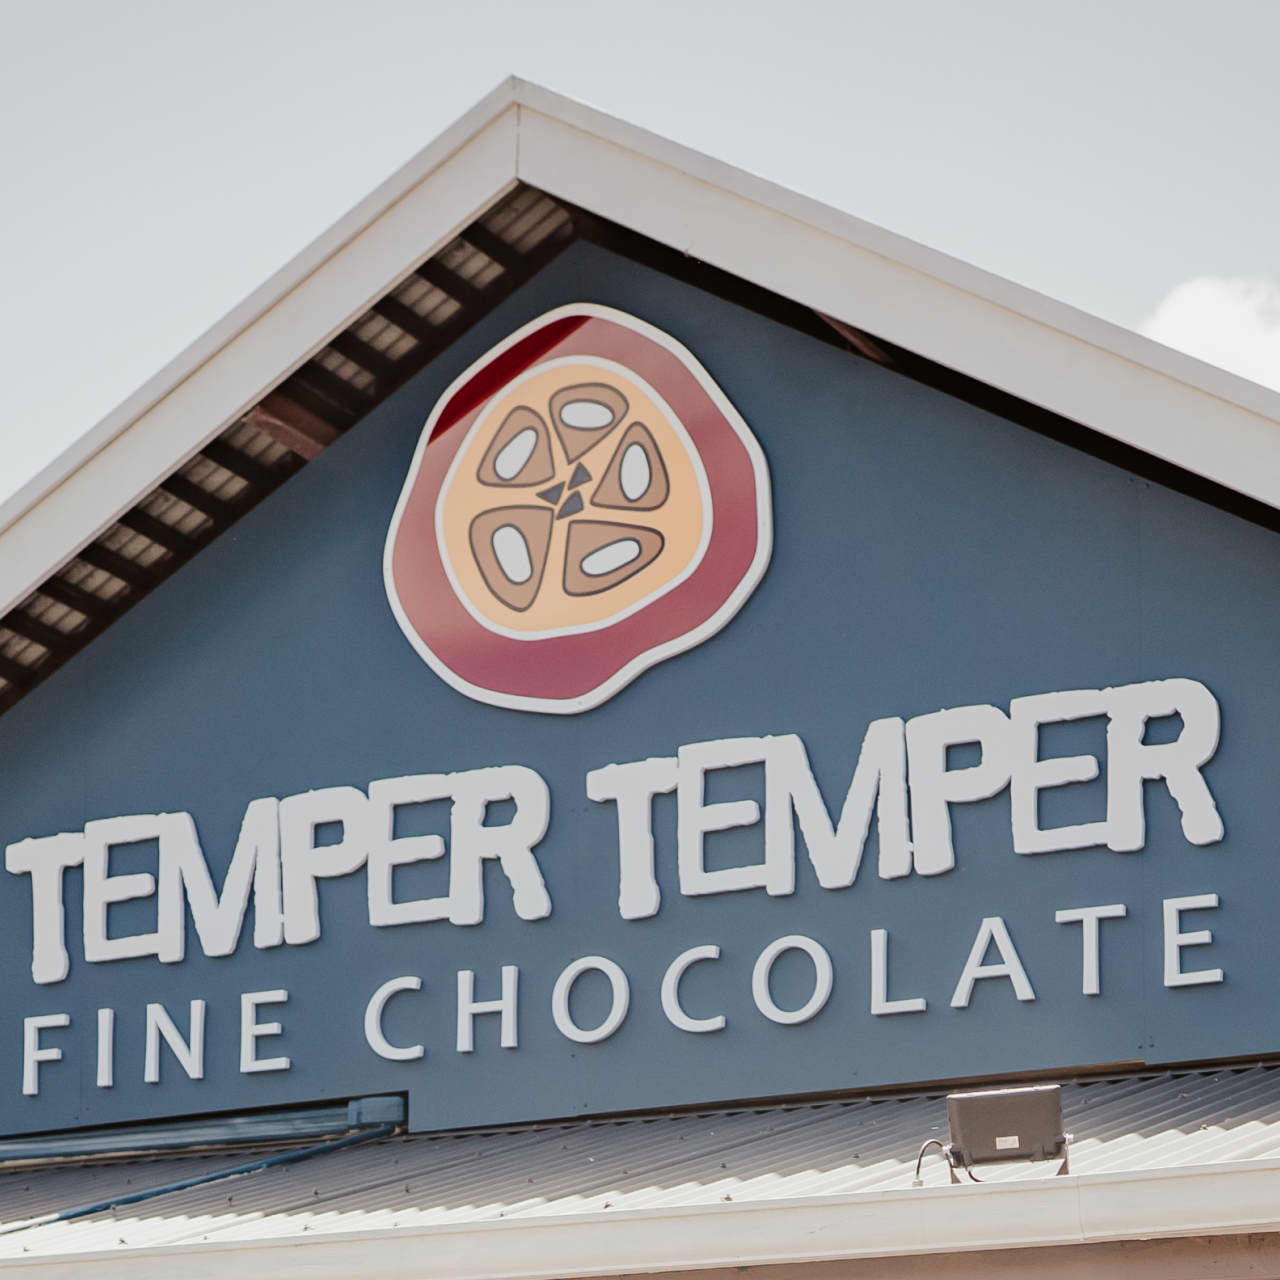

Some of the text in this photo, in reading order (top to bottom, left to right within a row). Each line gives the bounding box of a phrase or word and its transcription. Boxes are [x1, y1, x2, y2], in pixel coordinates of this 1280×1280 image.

[5, 677, 1225, 985] TEMPER TEMPER
[21, 893, 1224, 1097] FINE CHOCOLATE
